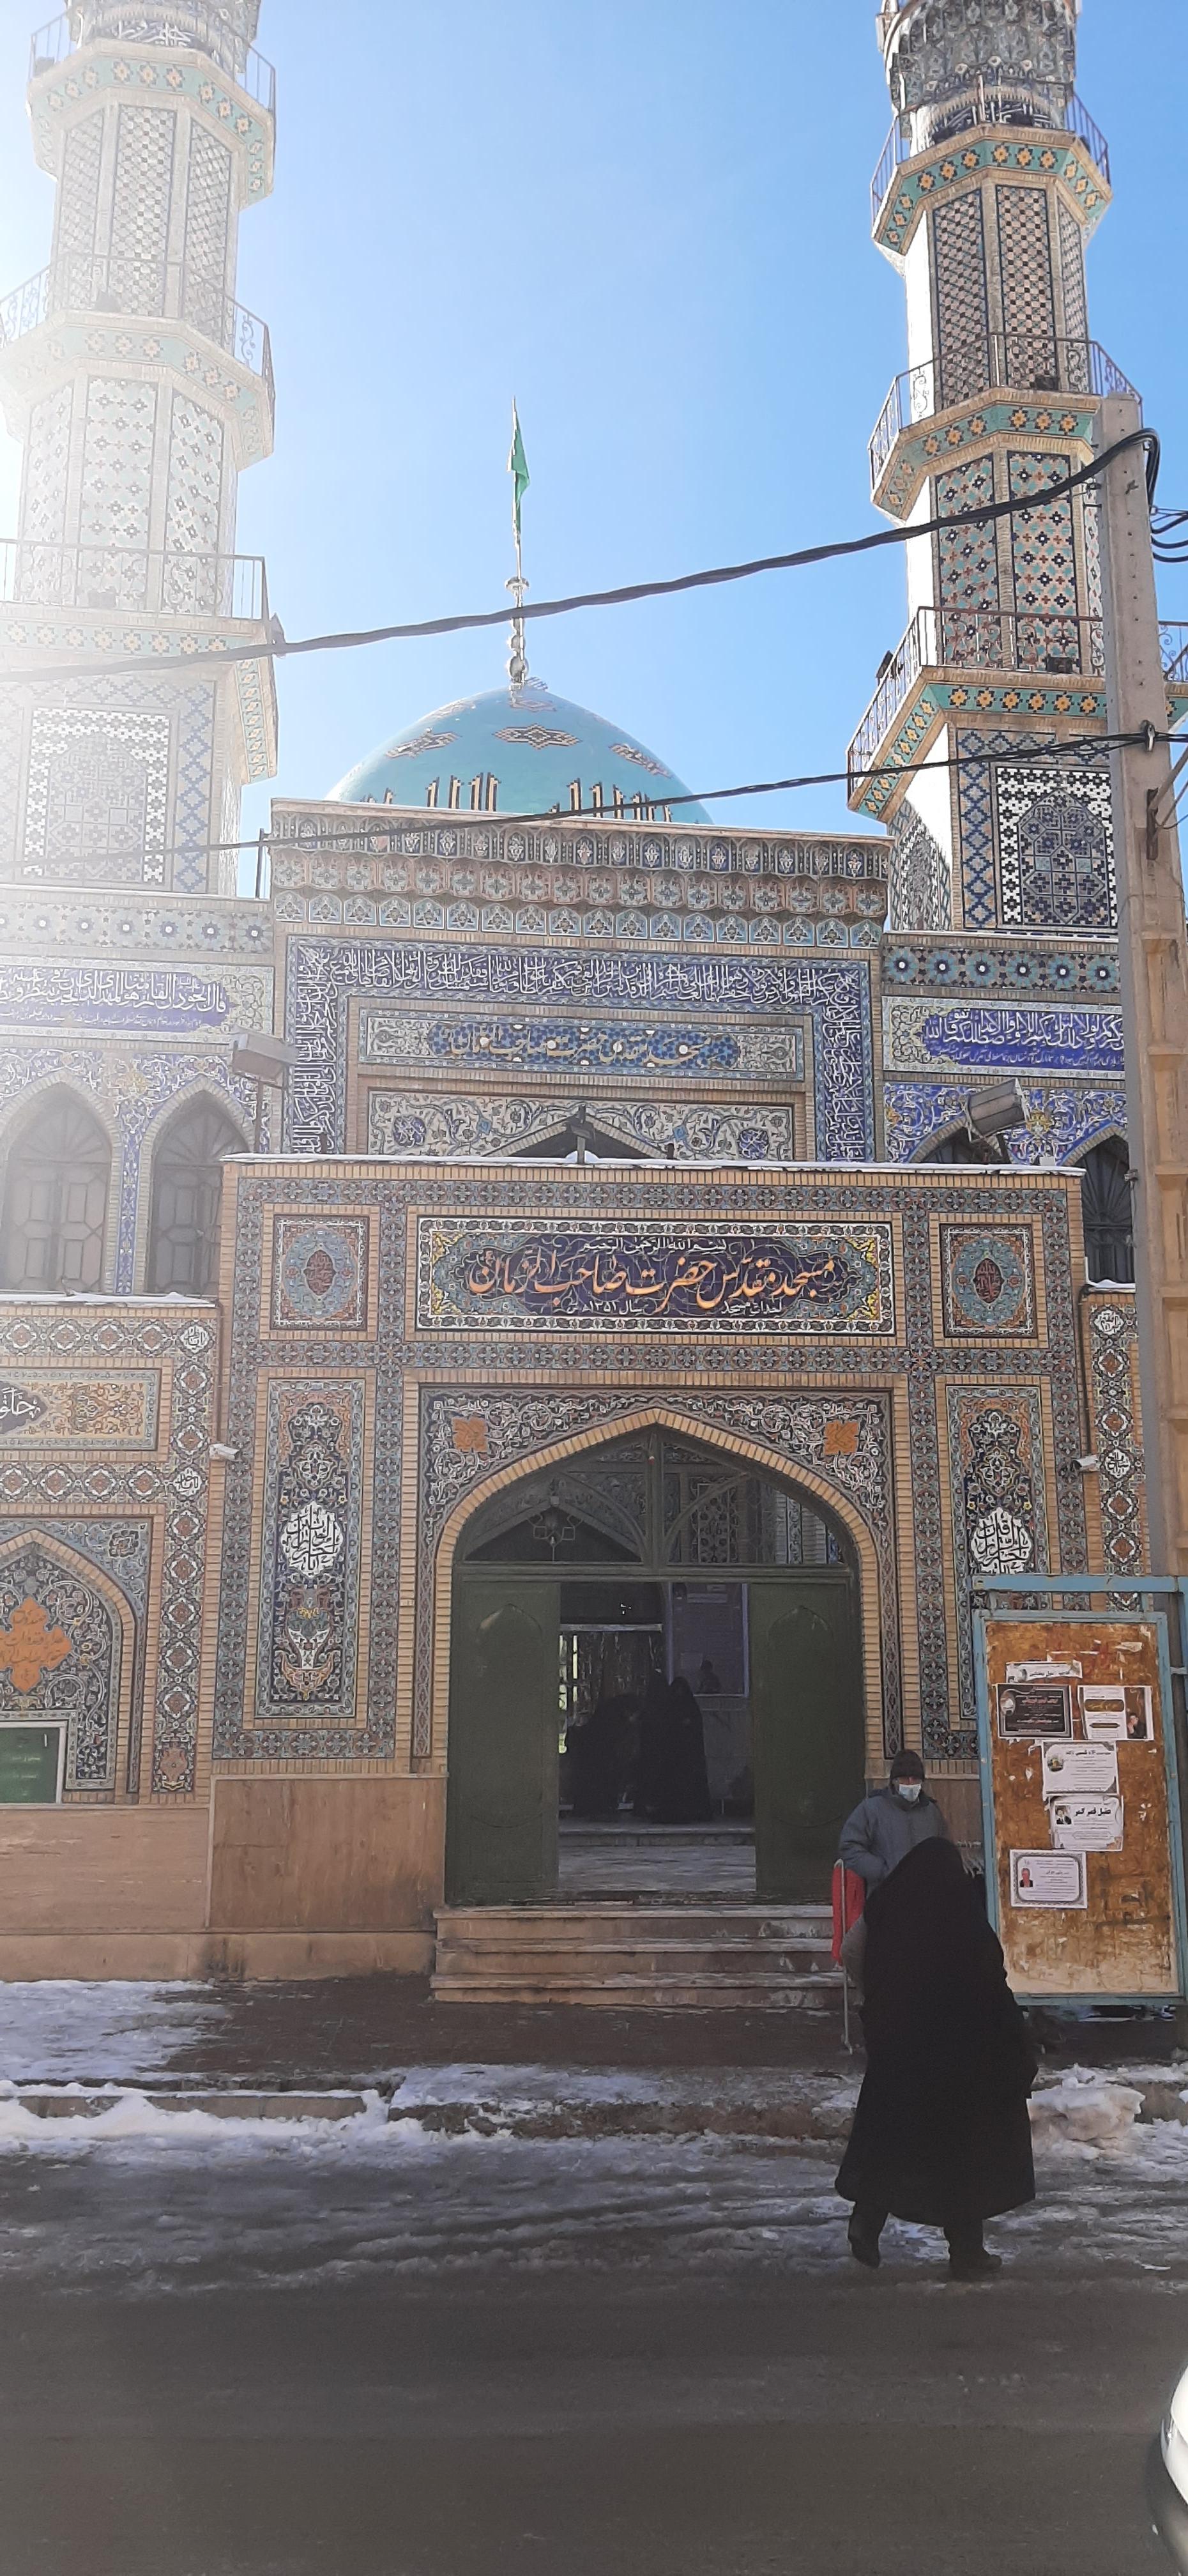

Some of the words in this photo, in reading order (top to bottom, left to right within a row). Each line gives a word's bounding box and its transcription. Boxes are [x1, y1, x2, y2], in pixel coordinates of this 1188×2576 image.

[669, 1238, 690, 1251] الله
[690, 1238, 727, 1254] بسم
[469, 1246, 558, 1294] الزمان
[534, 1252, 627, 1307] صاحب
[626, 1256, 718, 1314] حضرت
[697, 1257, 776, 1309] مقدس
[769, 1259, 835, 1298] مسجد
